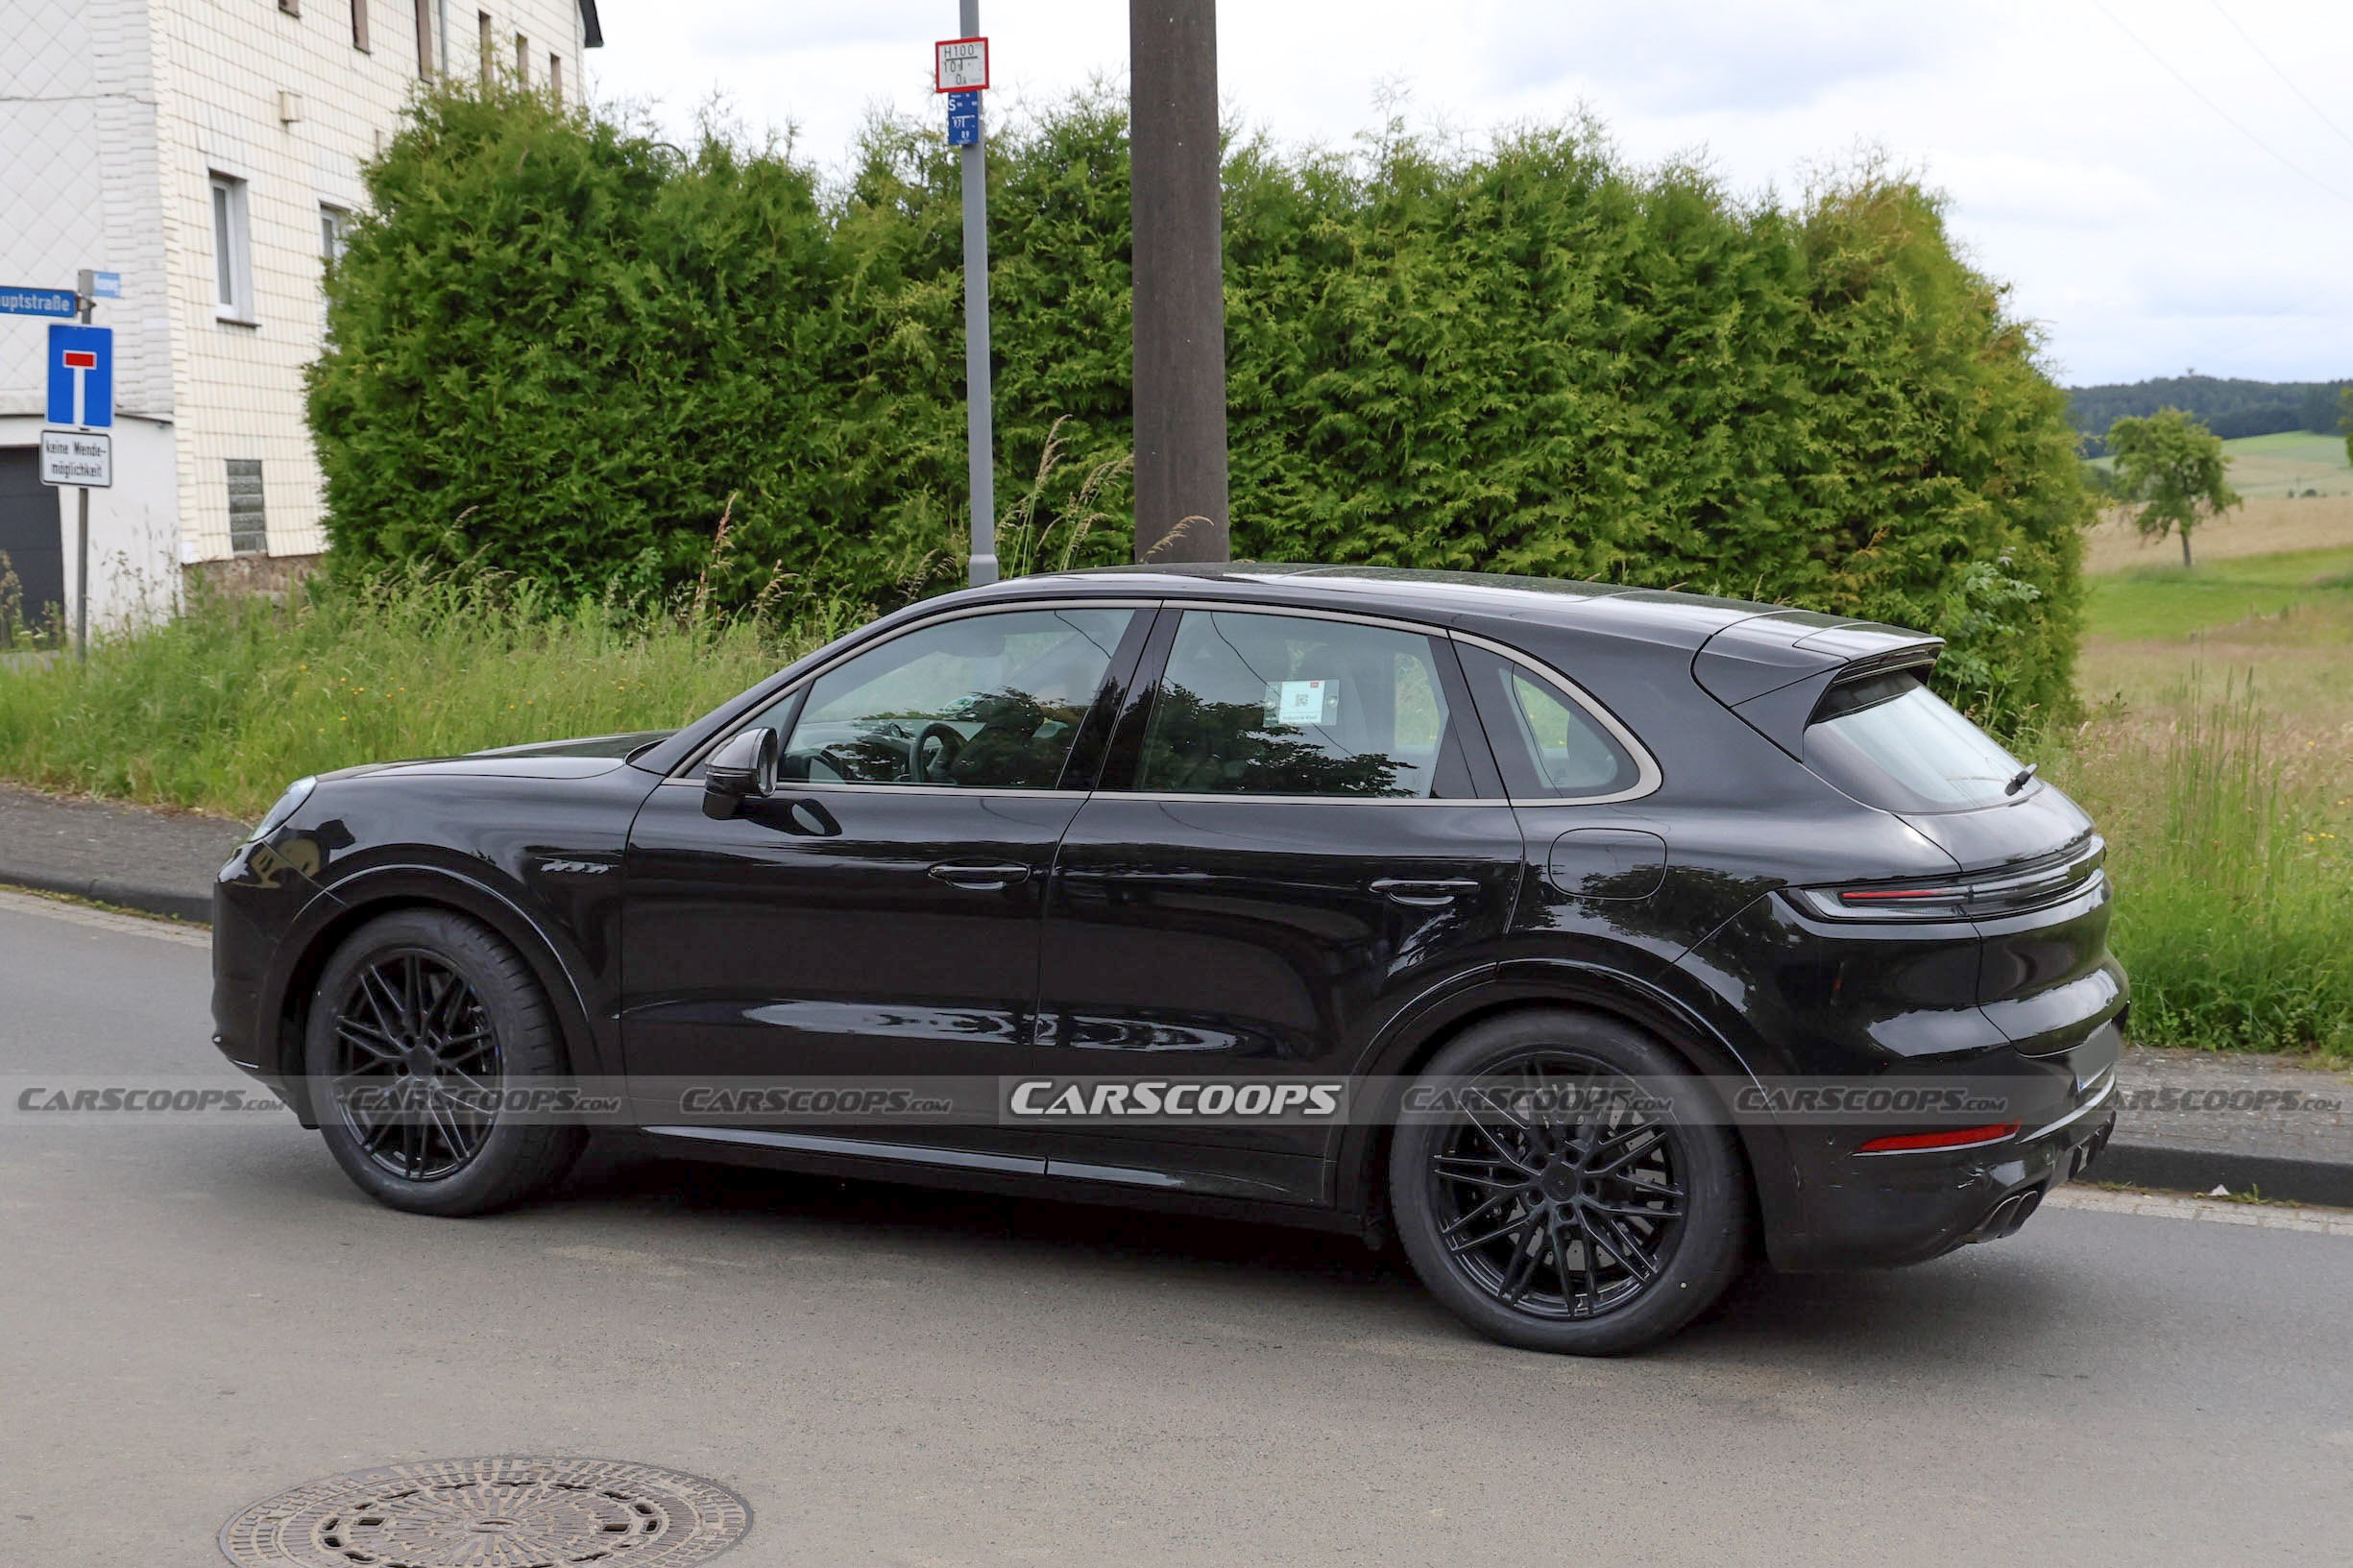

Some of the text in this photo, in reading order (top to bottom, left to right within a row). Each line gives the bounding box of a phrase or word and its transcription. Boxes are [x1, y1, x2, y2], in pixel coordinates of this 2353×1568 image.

[944, 44, 974, 59] H100
[0, 293, 70, 312] uptstraße
[46, 440, 108, 457] keine Wende-
[52, 461, 102, 479] möglichkeit
